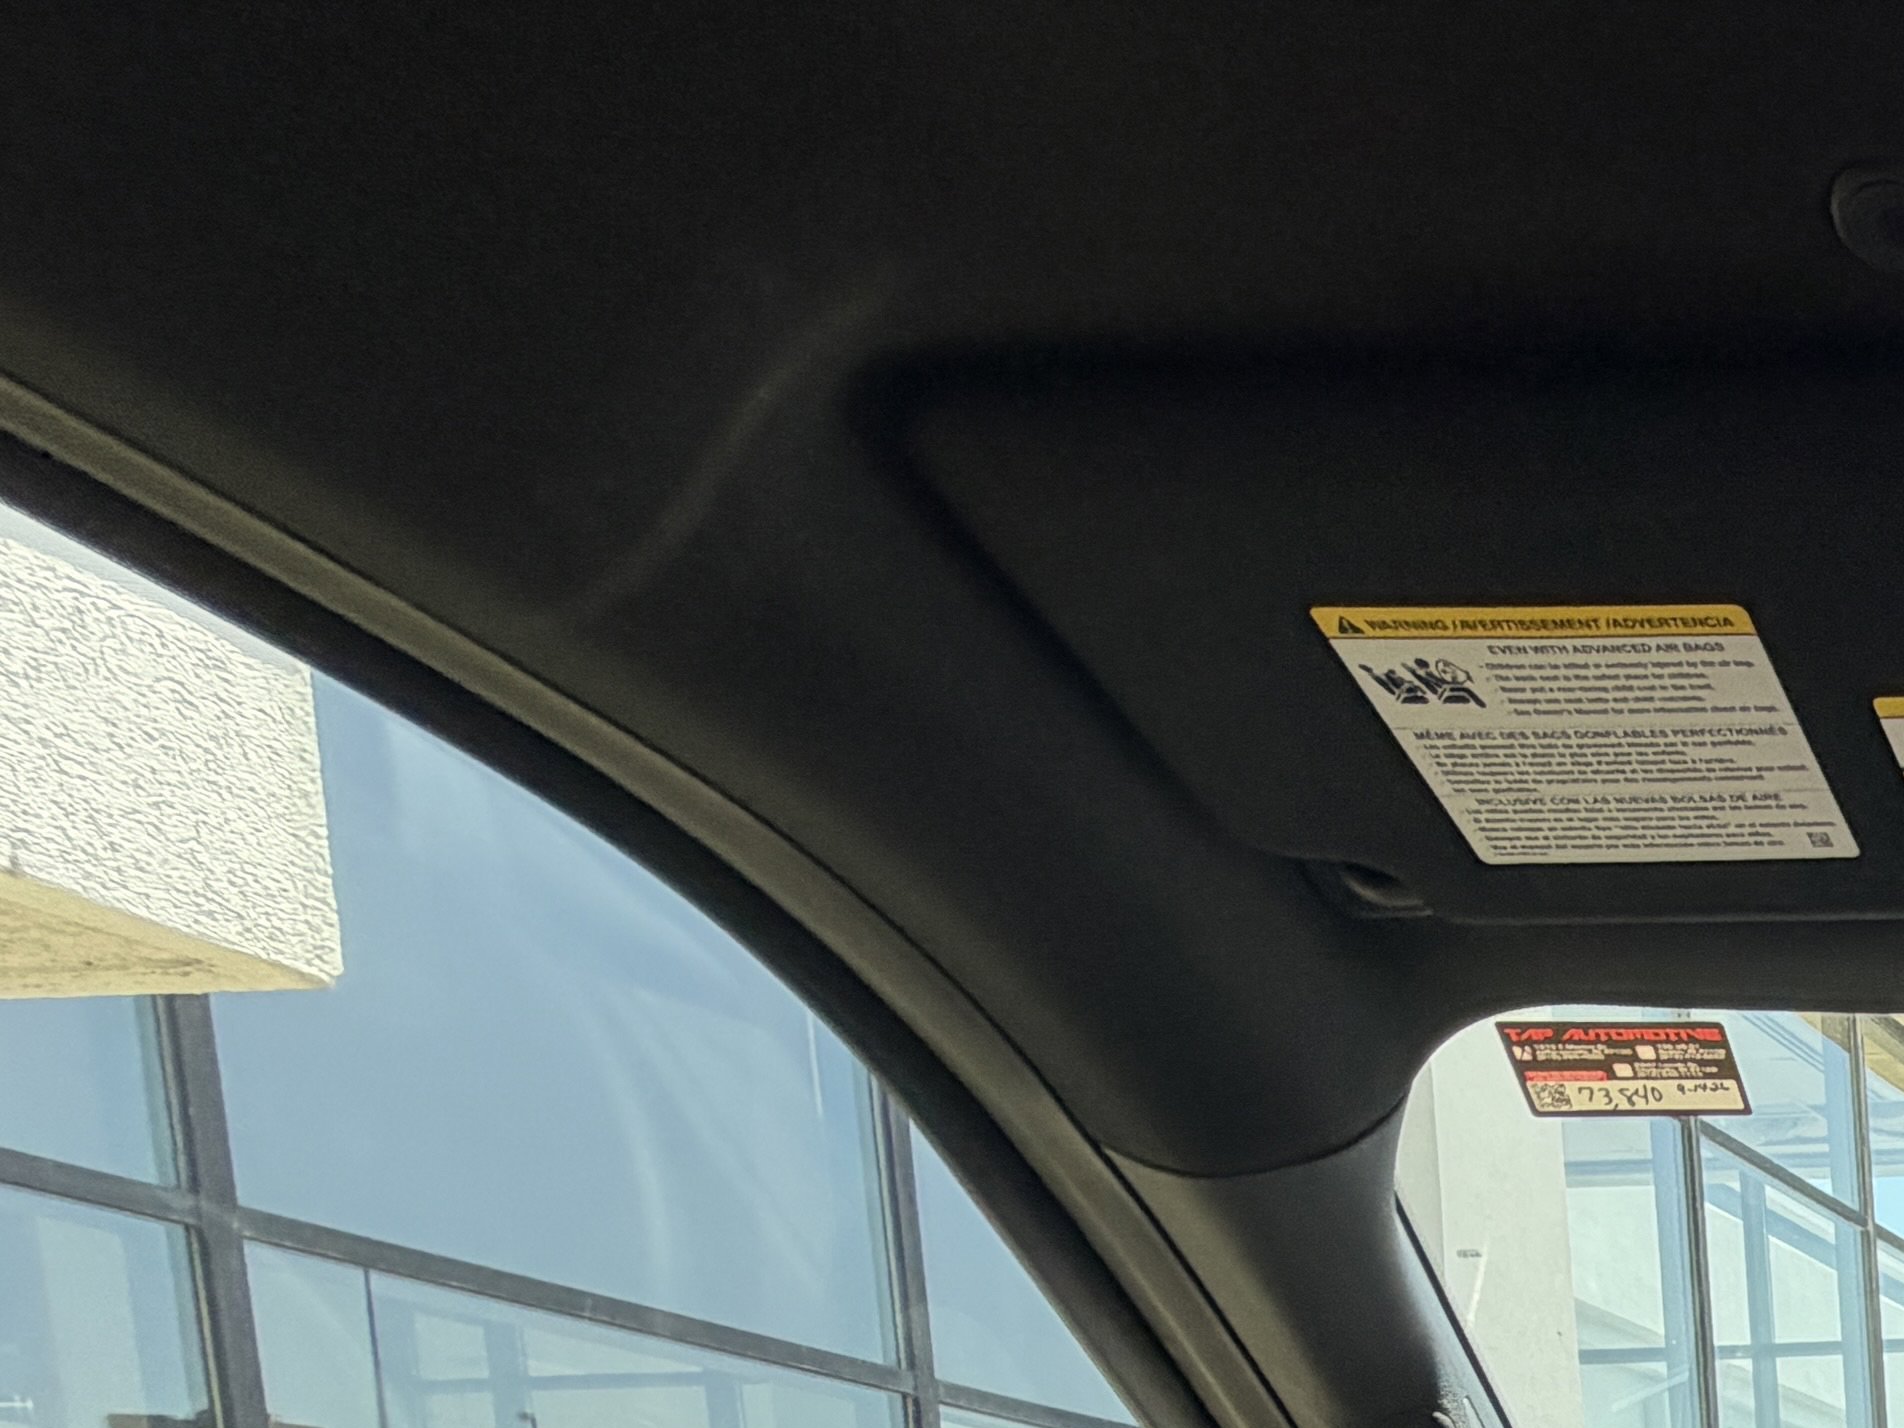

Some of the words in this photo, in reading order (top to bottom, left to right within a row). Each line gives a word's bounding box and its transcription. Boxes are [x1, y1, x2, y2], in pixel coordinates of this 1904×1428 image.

[1364, 618, 1447, 631] WARNING
[1487, 645, 1528, 655] EVEN
[1533, 645, 1569, 654] WITH
[1572, 643, 1651, 654] ADVANCED
[1503, 1028, 1554, 1042] TAP
[1562, 1027, 1723, 1042] AUTOMOTIVE
[1577, 1083, 1663, 1111] 73,840
